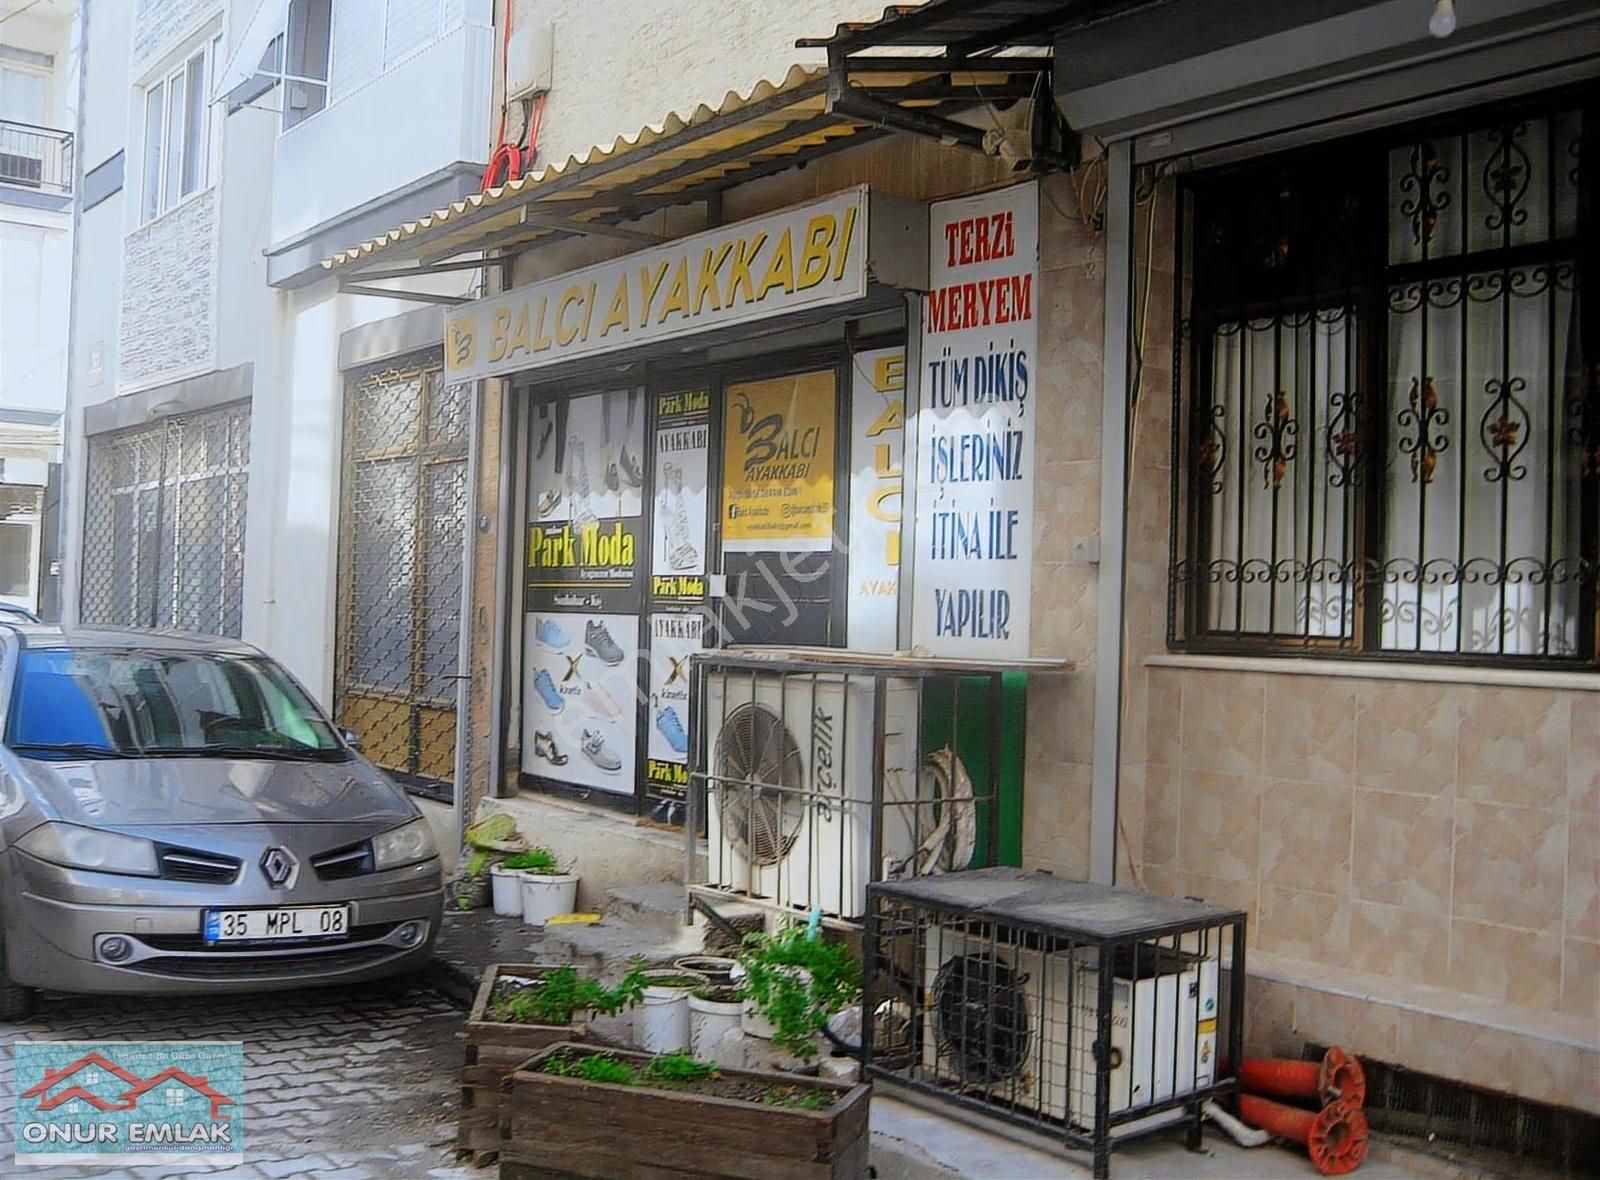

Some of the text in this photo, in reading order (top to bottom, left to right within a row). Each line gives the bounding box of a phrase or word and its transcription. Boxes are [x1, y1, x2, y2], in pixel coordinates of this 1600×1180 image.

[488, 206, 857, 363] BALCI AYAKKABI
[927, 273, 1032, 334] MERYEM
[929, 338, 1029, 417] TÜM DİKİŞ
[745, 462, 811, 482] AYAKKABI
[930, 417, 1024, 499] İŞLERİNİZ
[527, 521, 635, 568] Park Moda
[931, 497, 1019, 560] İTİNA İLE
[652, 576, 705, 596] Park Moda
[935, 588, 1011, 640] YAPILIR
[223, 910, 343, 937] 35 MPL 08
